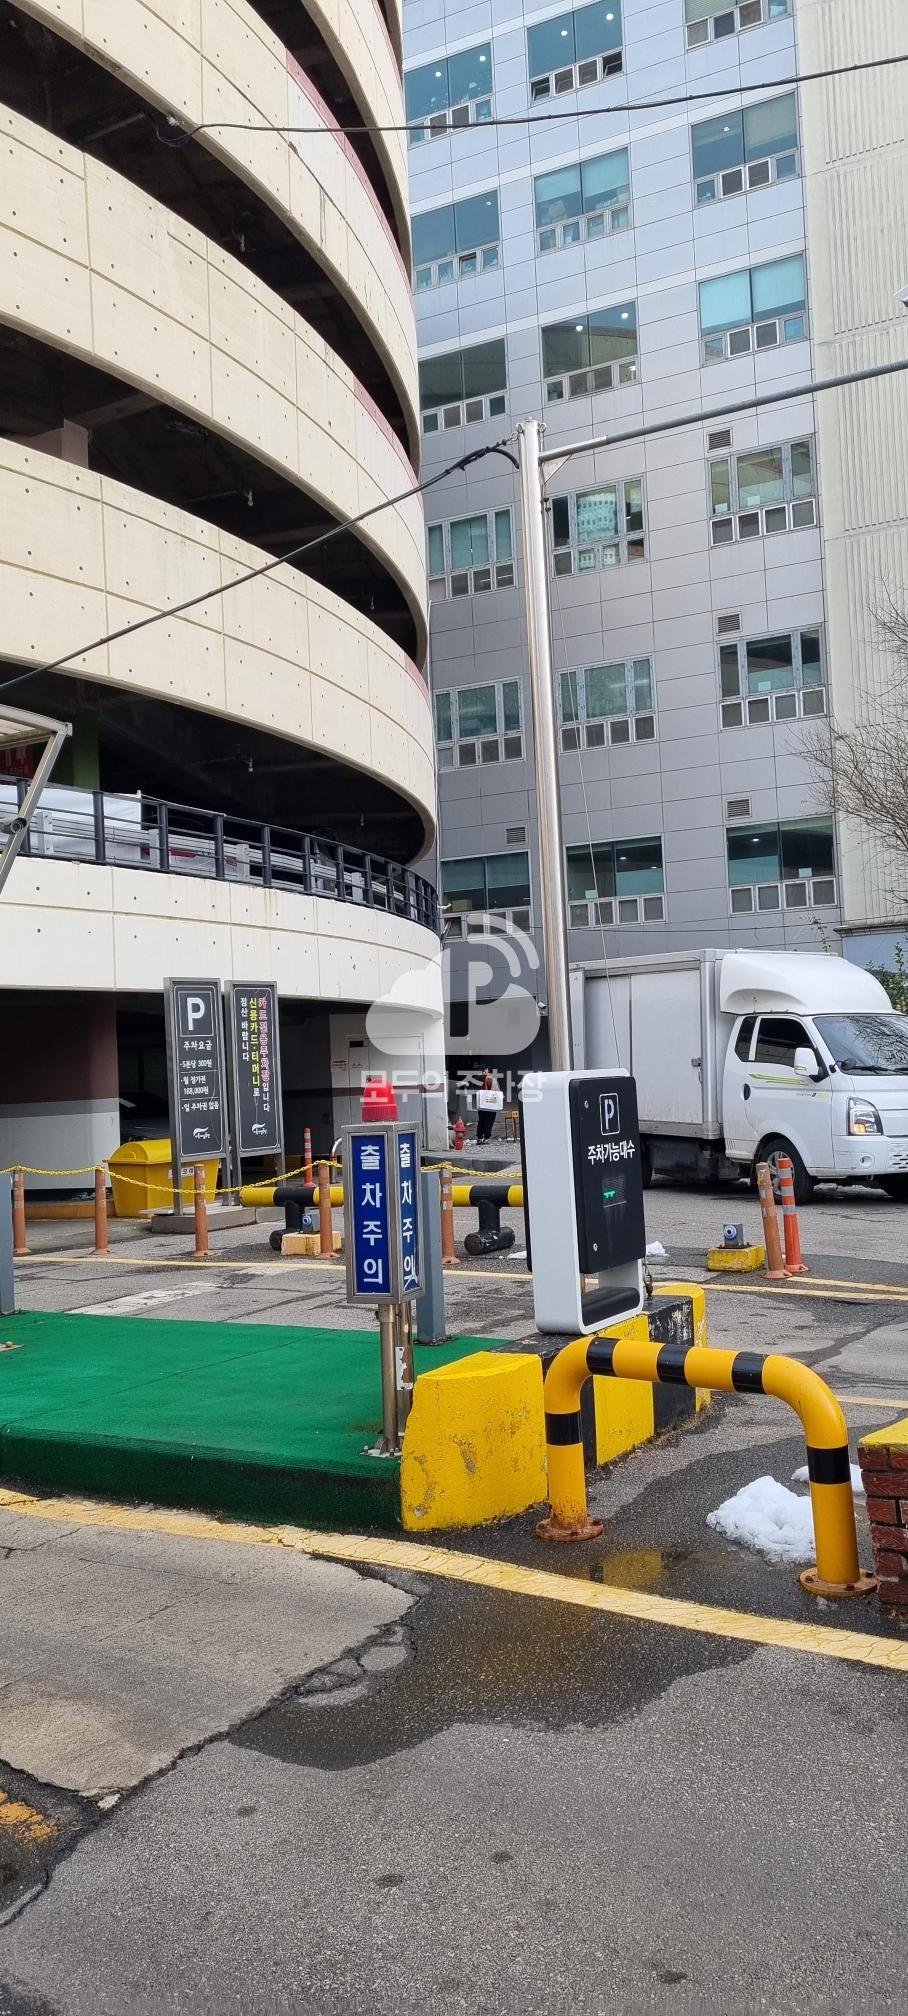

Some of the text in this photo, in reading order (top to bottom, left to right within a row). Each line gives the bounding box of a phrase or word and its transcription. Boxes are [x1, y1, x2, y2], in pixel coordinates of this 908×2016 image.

[187, 997, 205, 1030] P
[240, 997, 249, 1061] 정산 바랍니다
[183, 1040, 213, 1051] 주차요금
[197, 1058, 213, 1068] 300원
[190, 1074, 207, 1085] 정기권
[190, 1101, 208, 1111] 주차권
[208, 1100, 220, 1110] 없음
[604, 1098, 615, 1130] P
[587, 1139, 636, 1166] 주차가능대수
[360, 1144, 383, 1285] 출차주의
[400, 1143, 416, 1284] 출차주의
